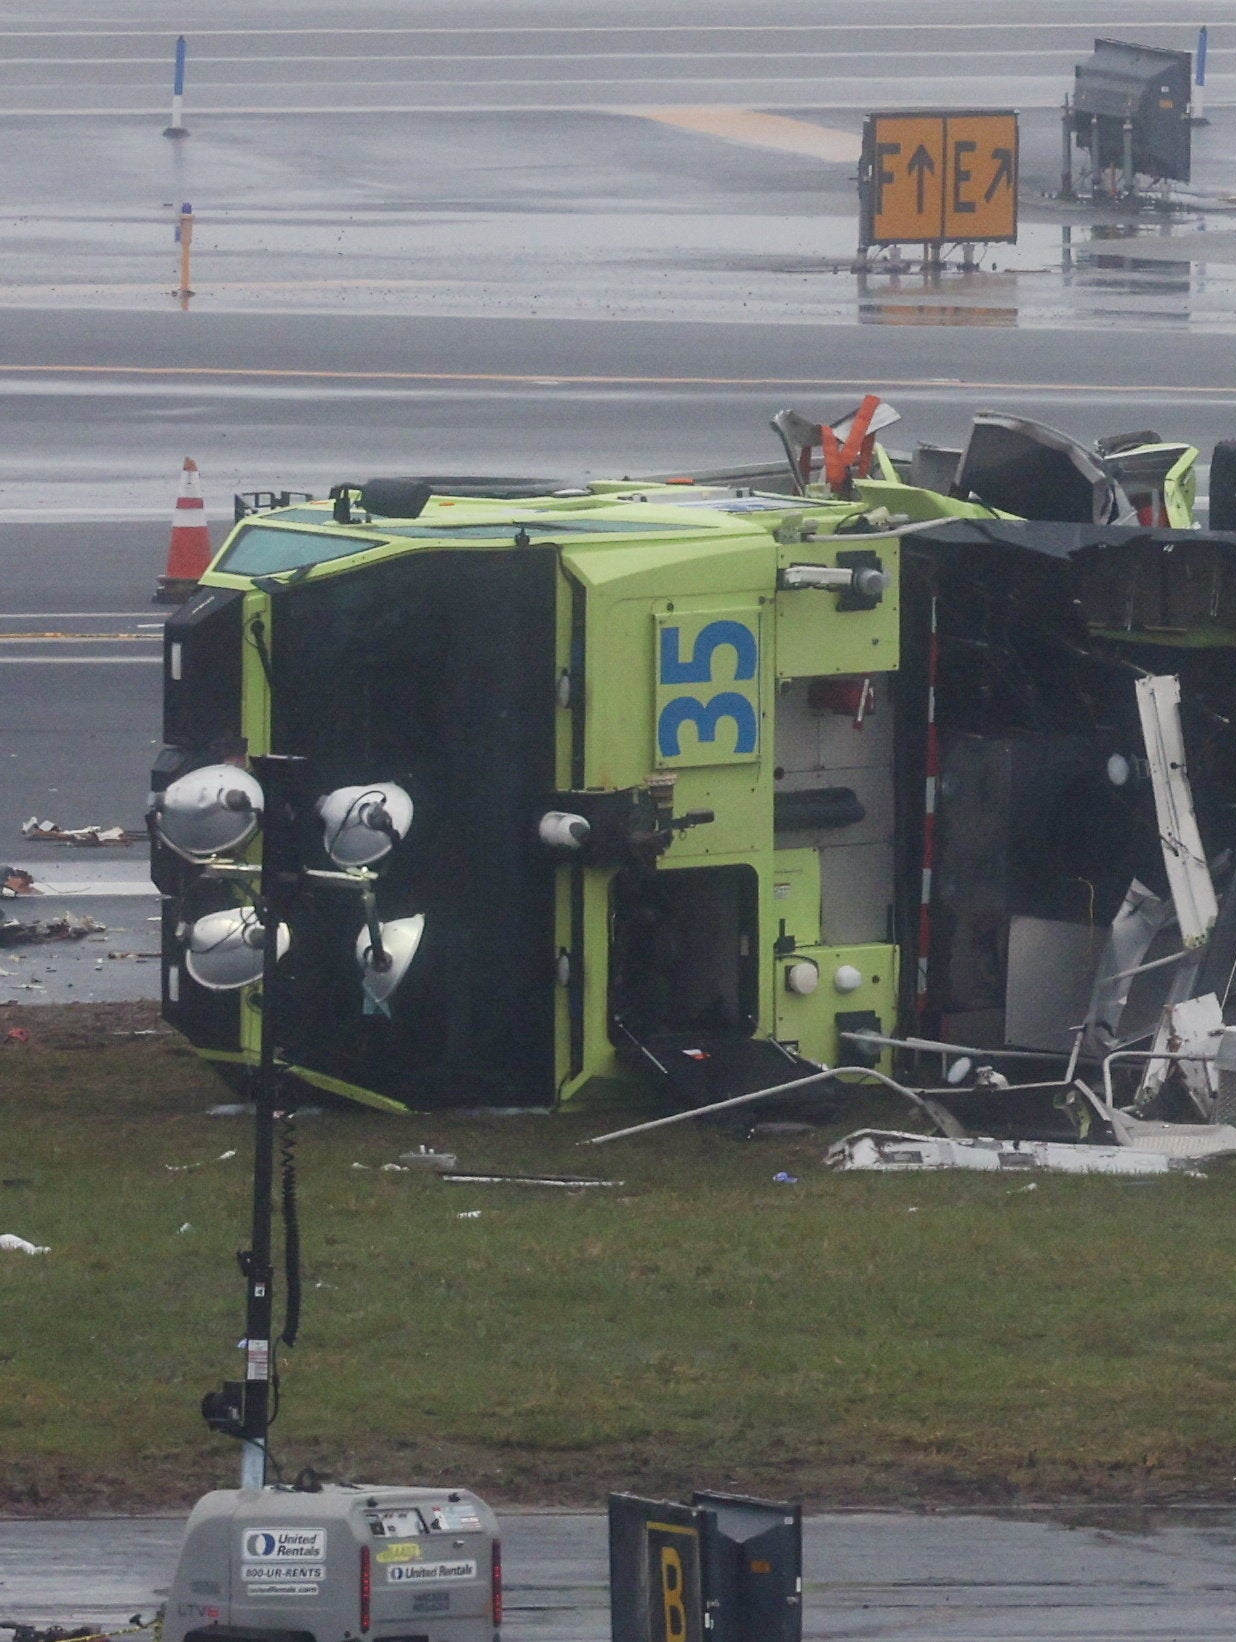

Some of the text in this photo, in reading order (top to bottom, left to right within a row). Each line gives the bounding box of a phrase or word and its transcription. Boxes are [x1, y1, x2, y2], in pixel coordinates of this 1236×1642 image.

[875, 140, 977, 215] F E
[658, 619, 757, 757] 35
[276, 1545, 320, 1556] Rentals
[278, 1533, 318, 1545] United
[405, 1564, 473, 1579] United Rentals
[661, 1546, 687, 1642] B
